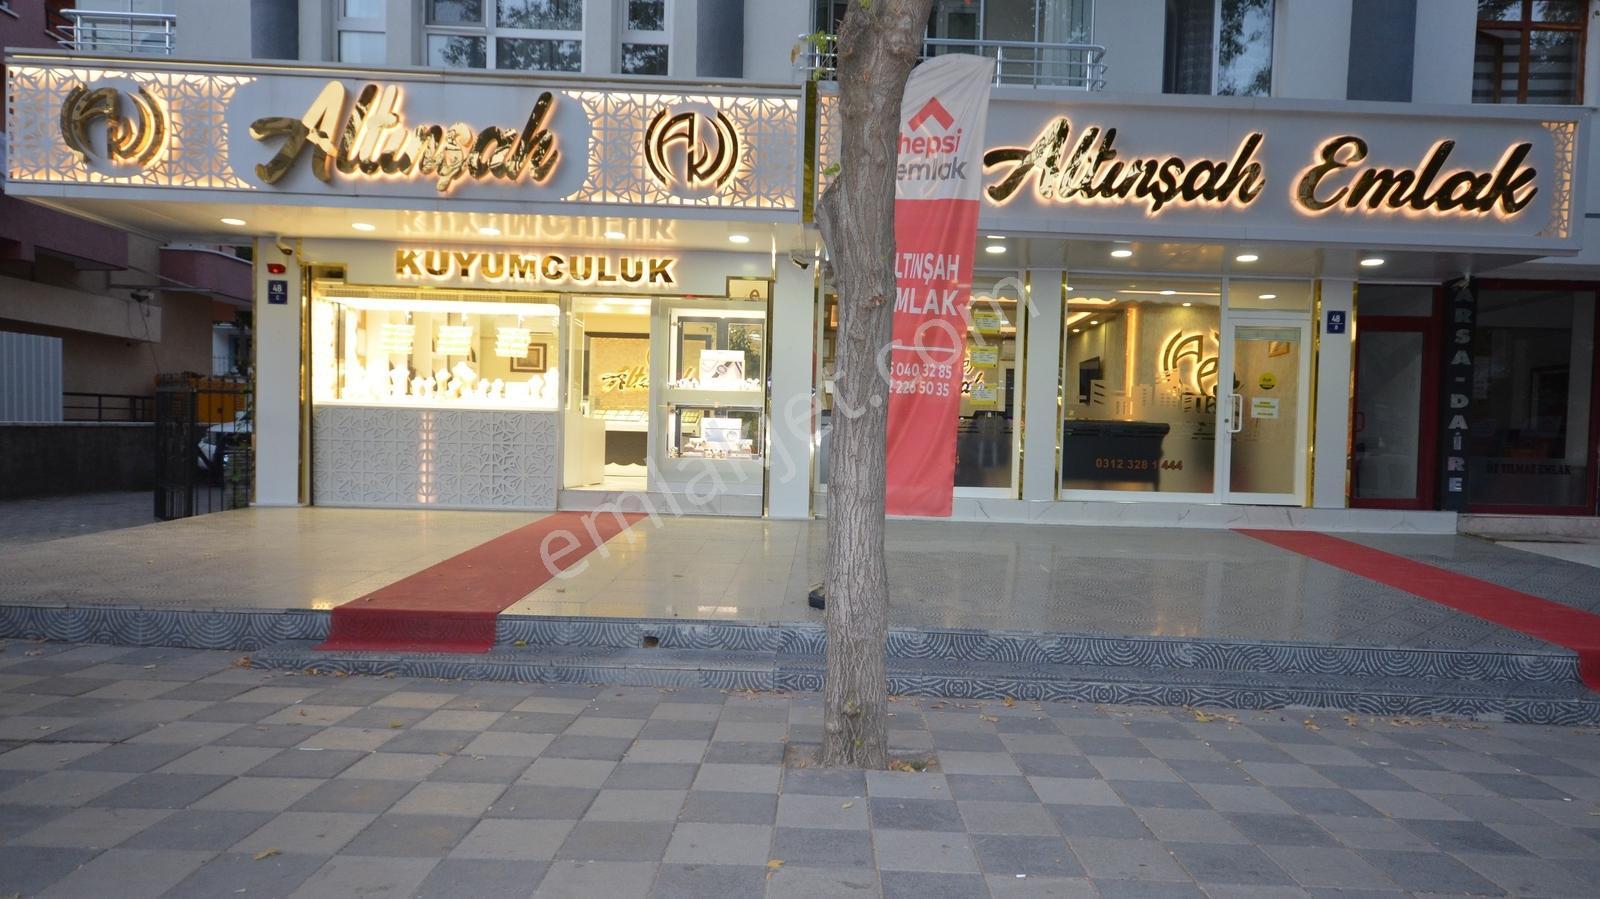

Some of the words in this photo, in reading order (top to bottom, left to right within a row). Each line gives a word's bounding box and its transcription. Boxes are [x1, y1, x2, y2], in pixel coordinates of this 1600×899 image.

[249, 80, 560, 192] Altınşah
[897, 128, 962, 159] hepsi
[897, 157, 967, 181] emlak
[984, 117, 1266, 213] Altınşah
[1296, 135, 1539, 214] Emlak
[395, 249, 674, 284] KUYUMCULUK
[894, 252, 960, 284] LTINŞAH
[893, 287, 959, 316] MLAK
[896, 362, 920, 377] 040
[922, 363, 936, 378] 32
[938, 364, 952, 379] 85
[919, 381, 935, 394] 50
[936, 382, 950, 396] 35
[1095, 458, 1124, 469] 0312
[1127, 460, 1148, 470] 328
